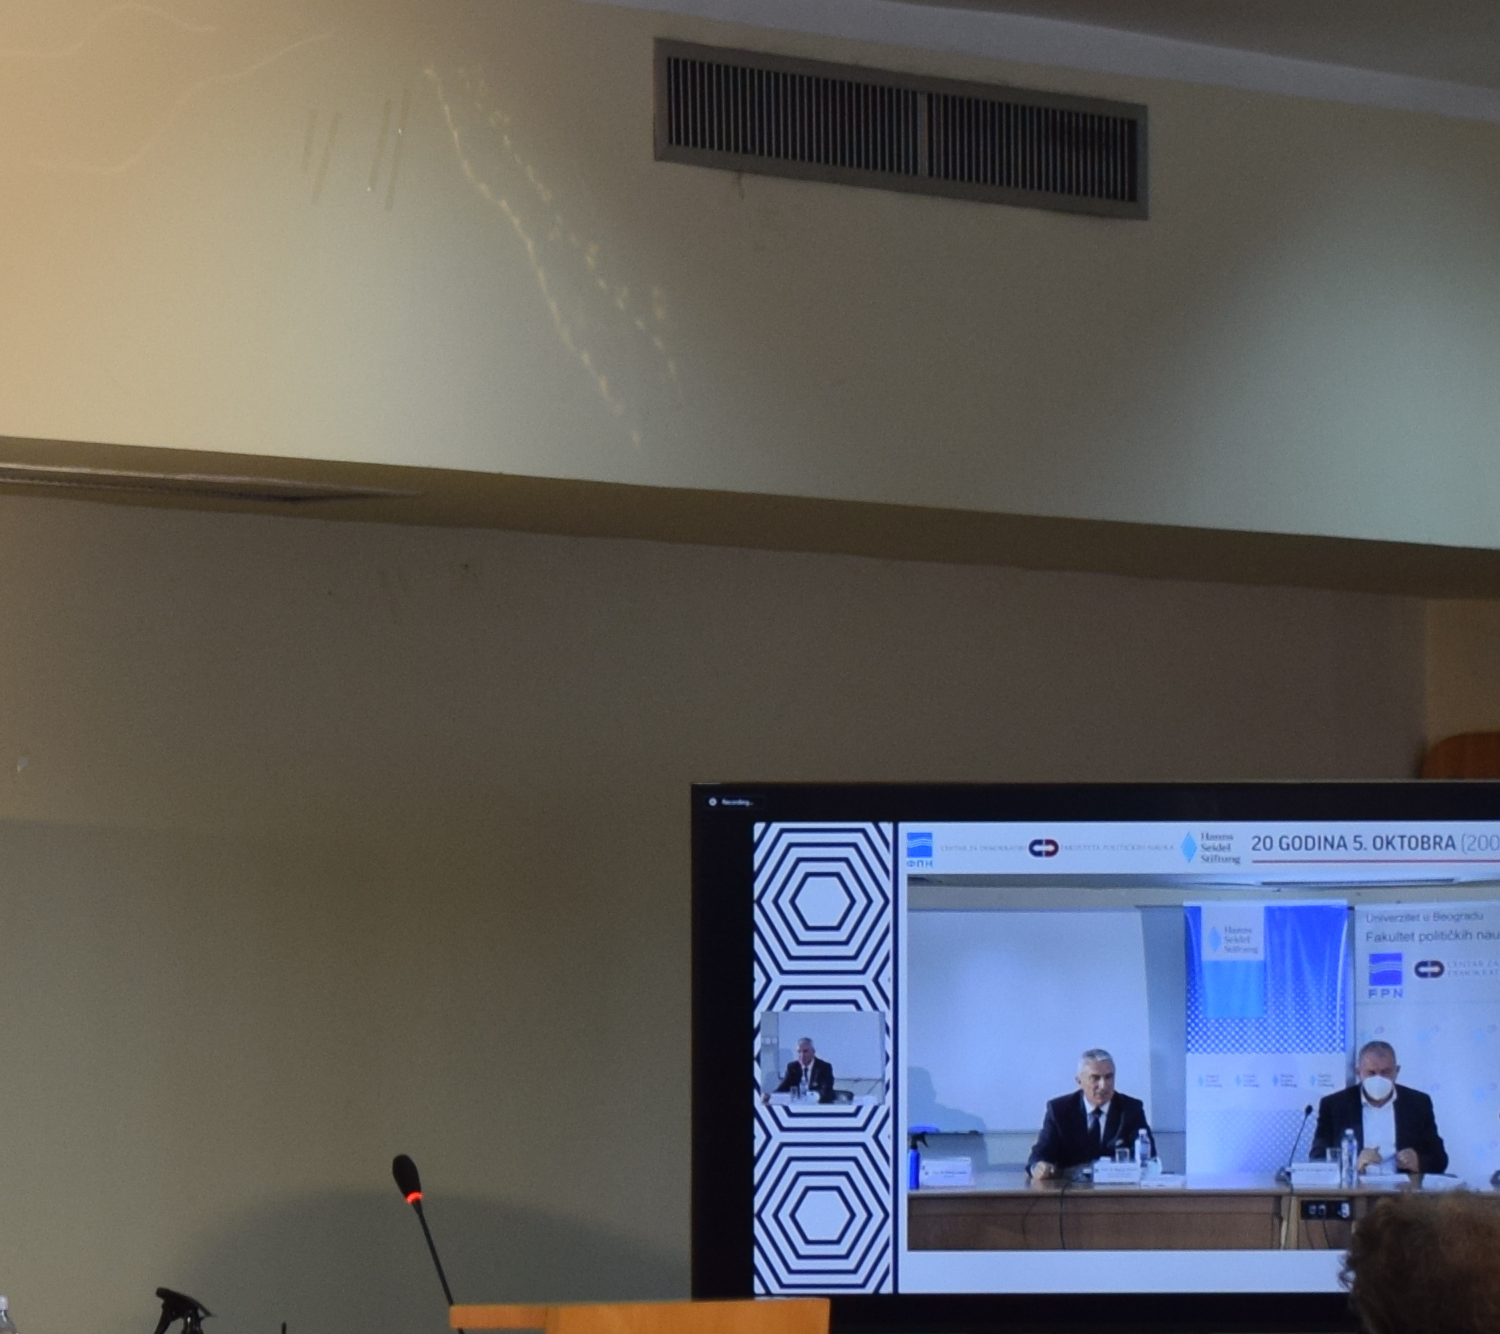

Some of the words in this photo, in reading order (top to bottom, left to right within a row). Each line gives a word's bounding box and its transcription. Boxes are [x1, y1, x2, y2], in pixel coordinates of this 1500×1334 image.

[1200, 832, 1234, 842] Hanns
[1251, 835, 1274, 852] 20
[1278, 834, 1348, 852] GODINA
[1352, 835, 1368, 852] 5.
[1372, 834, 1457, 852] OKTOBRA
[1200, 842, 1232, 853] Seidel
[1200, 853, 1242, 866] Stiftung
[1432, 910, 1485, 924] Beogradu
[1365, 930, 1416, 943] Fakultet
[1418, 929, 1474, 943] političkih
[1367, 987, 1404, 1000] FPN
